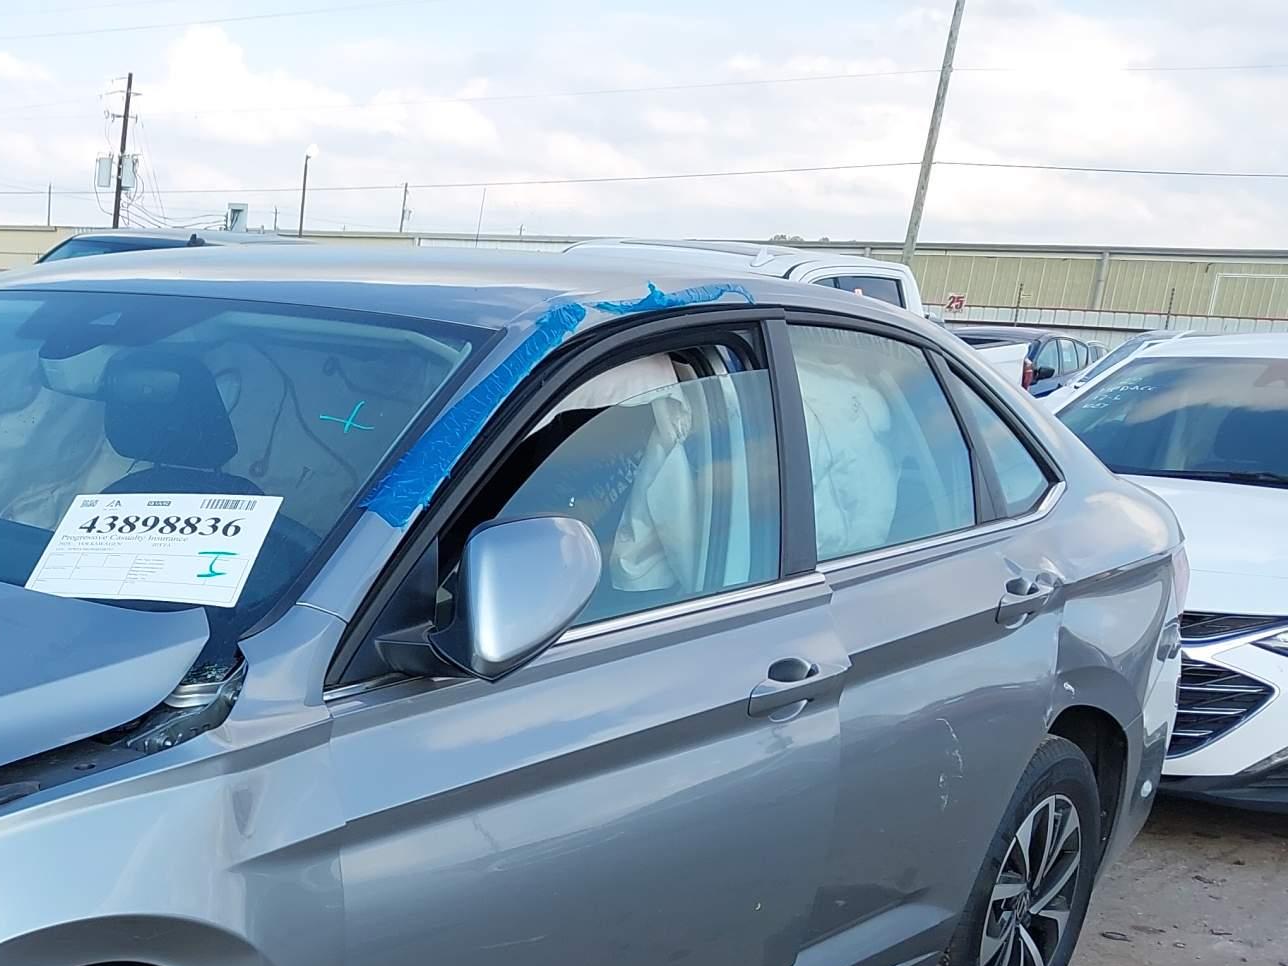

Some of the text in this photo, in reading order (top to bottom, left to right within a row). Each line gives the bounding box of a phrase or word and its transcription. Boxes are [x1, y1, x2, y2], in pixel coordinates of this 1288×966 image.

[946, 295, 965, 310] 25
[78, 515, 246, 537] 43898836
[61, 534, 189, 543] Progressive Casualty Insurance
